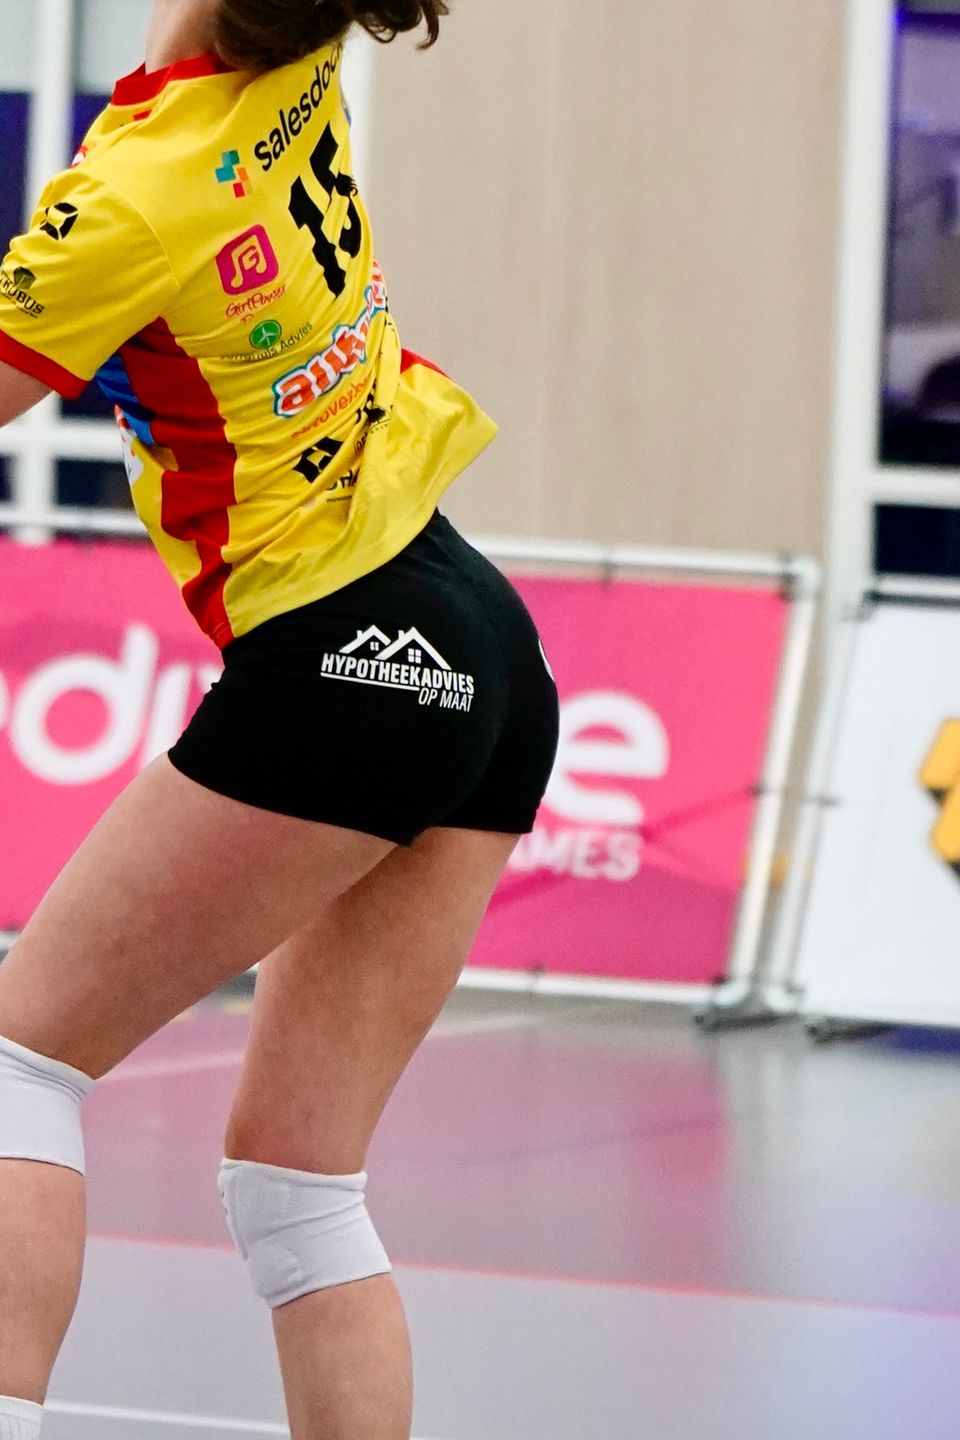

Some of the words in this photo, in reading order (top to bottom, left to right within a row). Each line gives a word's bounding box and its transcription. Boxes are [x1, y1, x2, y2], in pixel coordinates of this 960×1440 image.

[288, 120, 362, 299] 15
[279, 321, 313, 355] Advies
[320, 652, 475, 695] HYPOTHEEKADVIES
[418, 687, 438, 706] OP
[439, 691, 474, 713] MAAT
